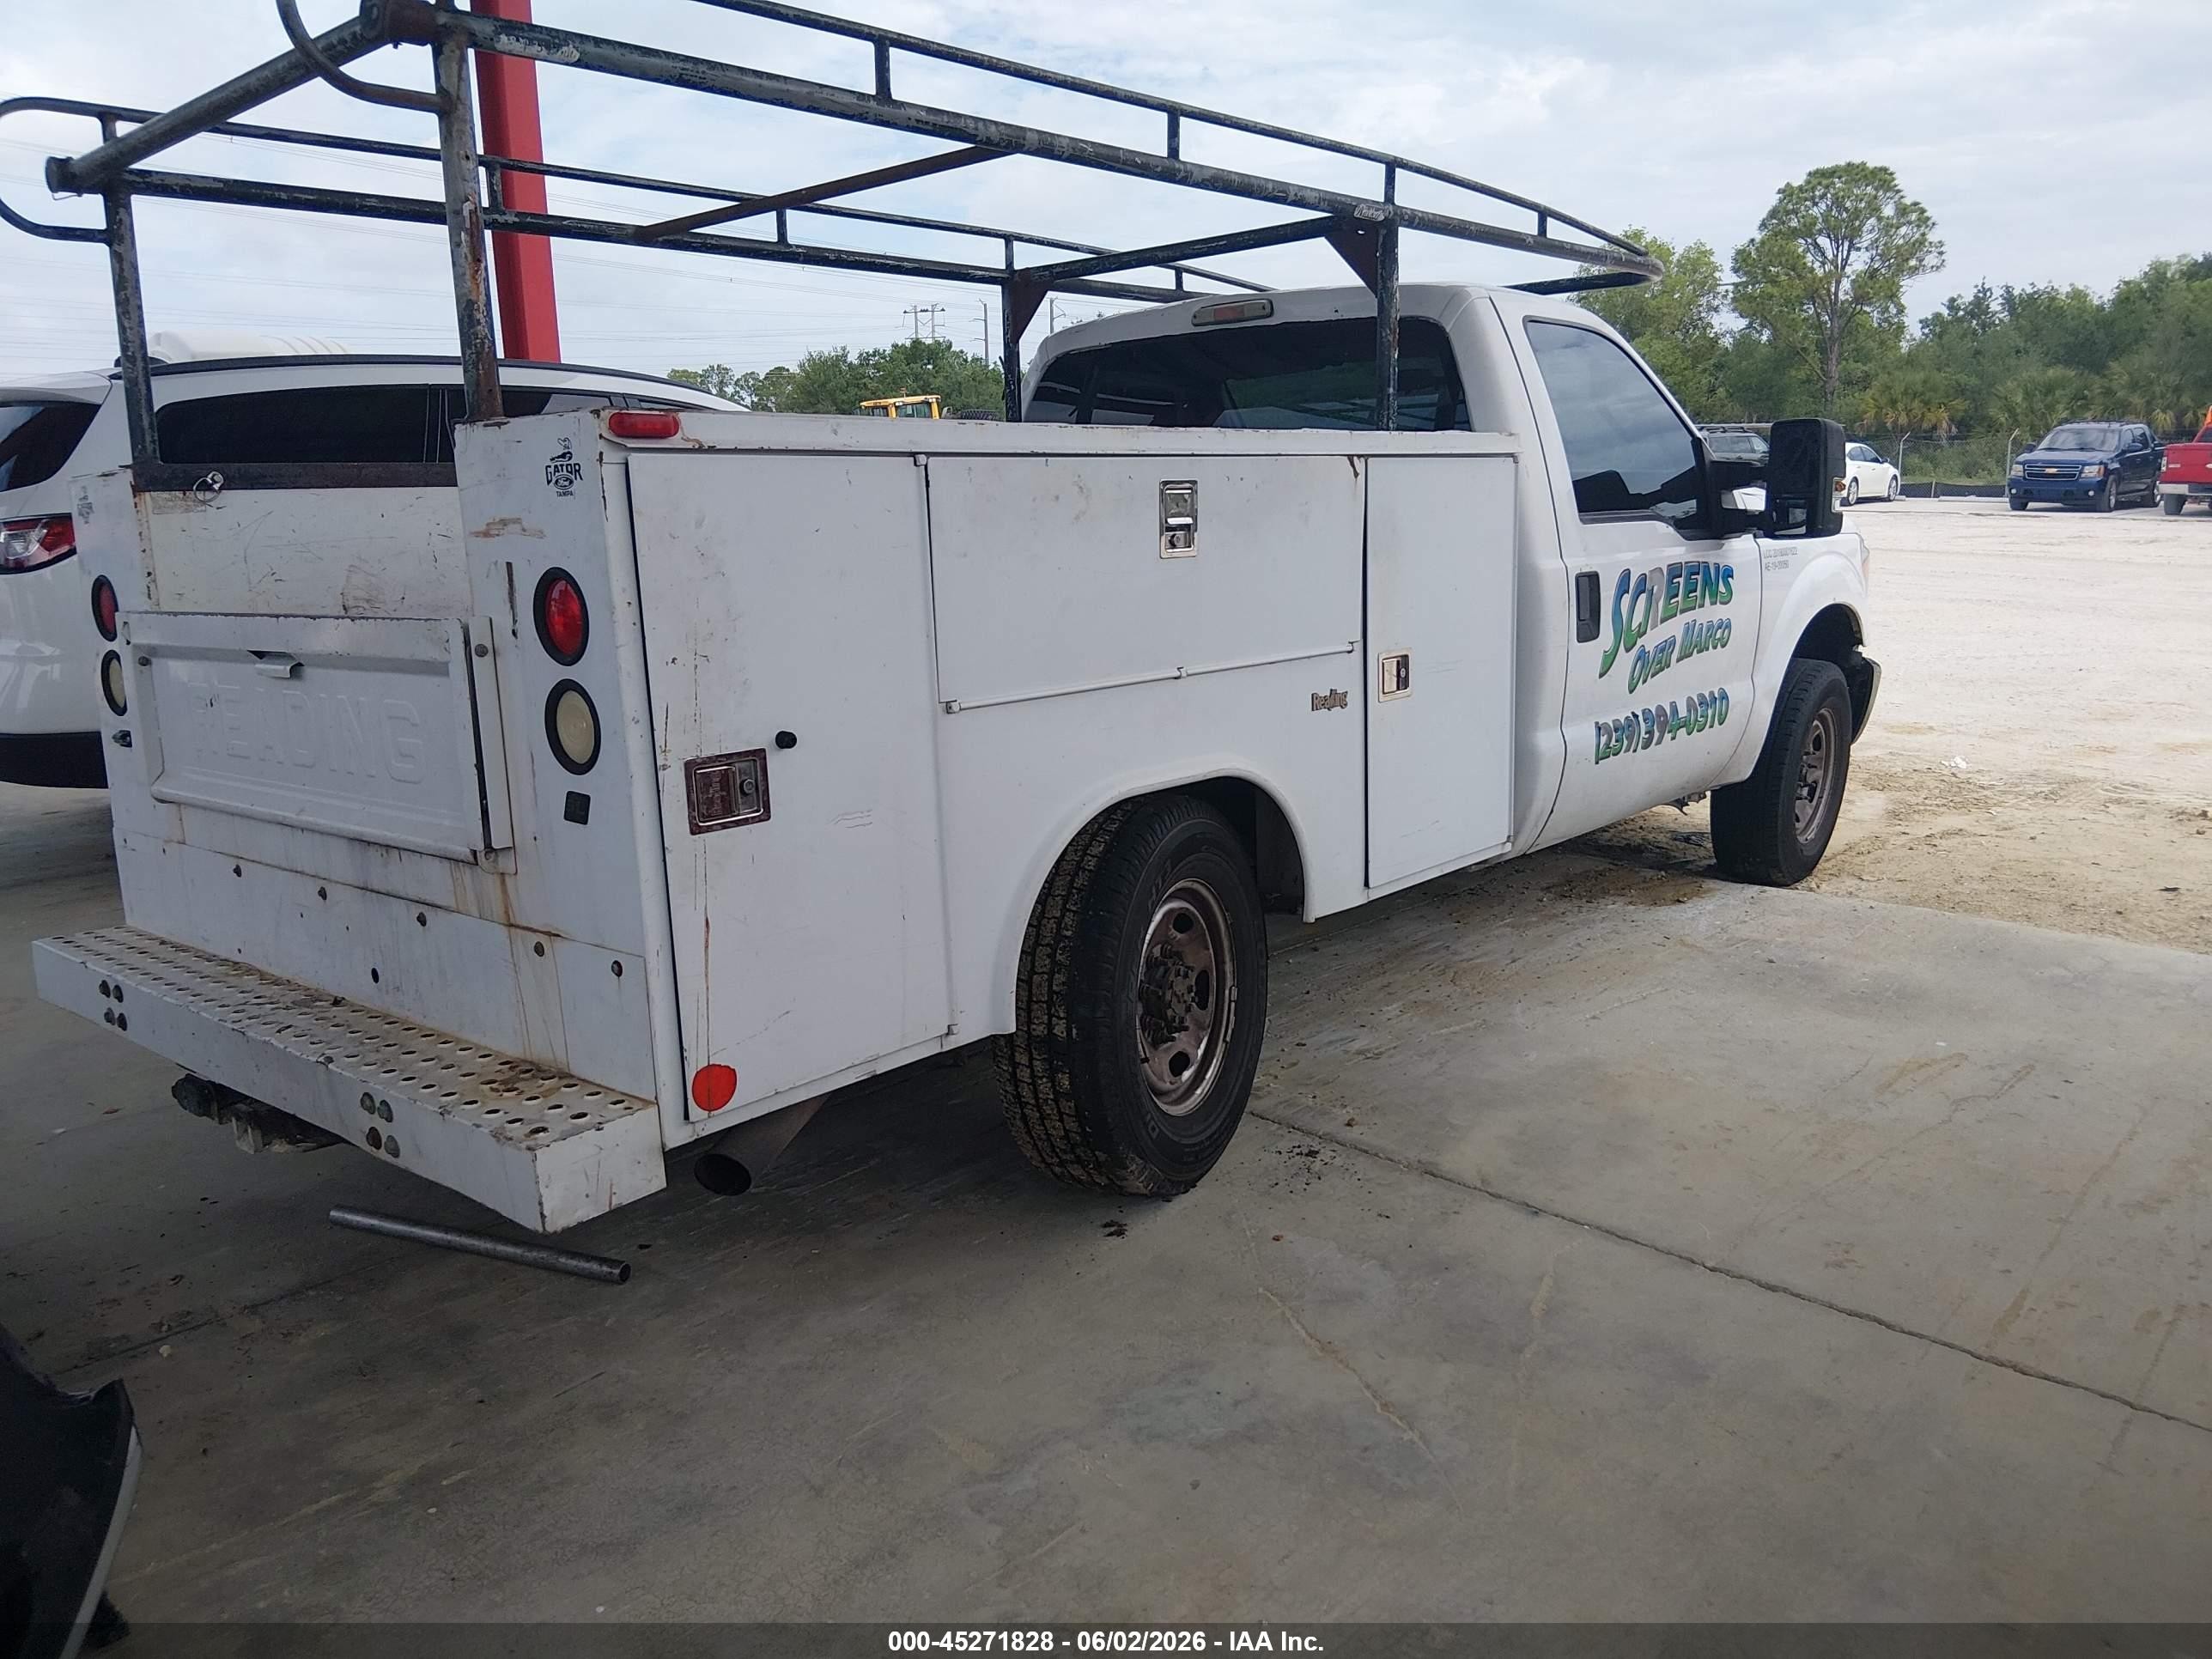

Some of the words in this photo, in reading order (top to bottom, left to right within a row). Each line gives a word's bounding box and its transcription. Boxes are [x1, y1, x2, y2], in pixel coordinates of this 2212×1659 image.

[544, 463, 583, 486] GATOR
[1598, 561, 1735, 678] SCREENS
[1628, 635, 1676, 694] OVER
[1676, 618, 1732, 663] MARCO
